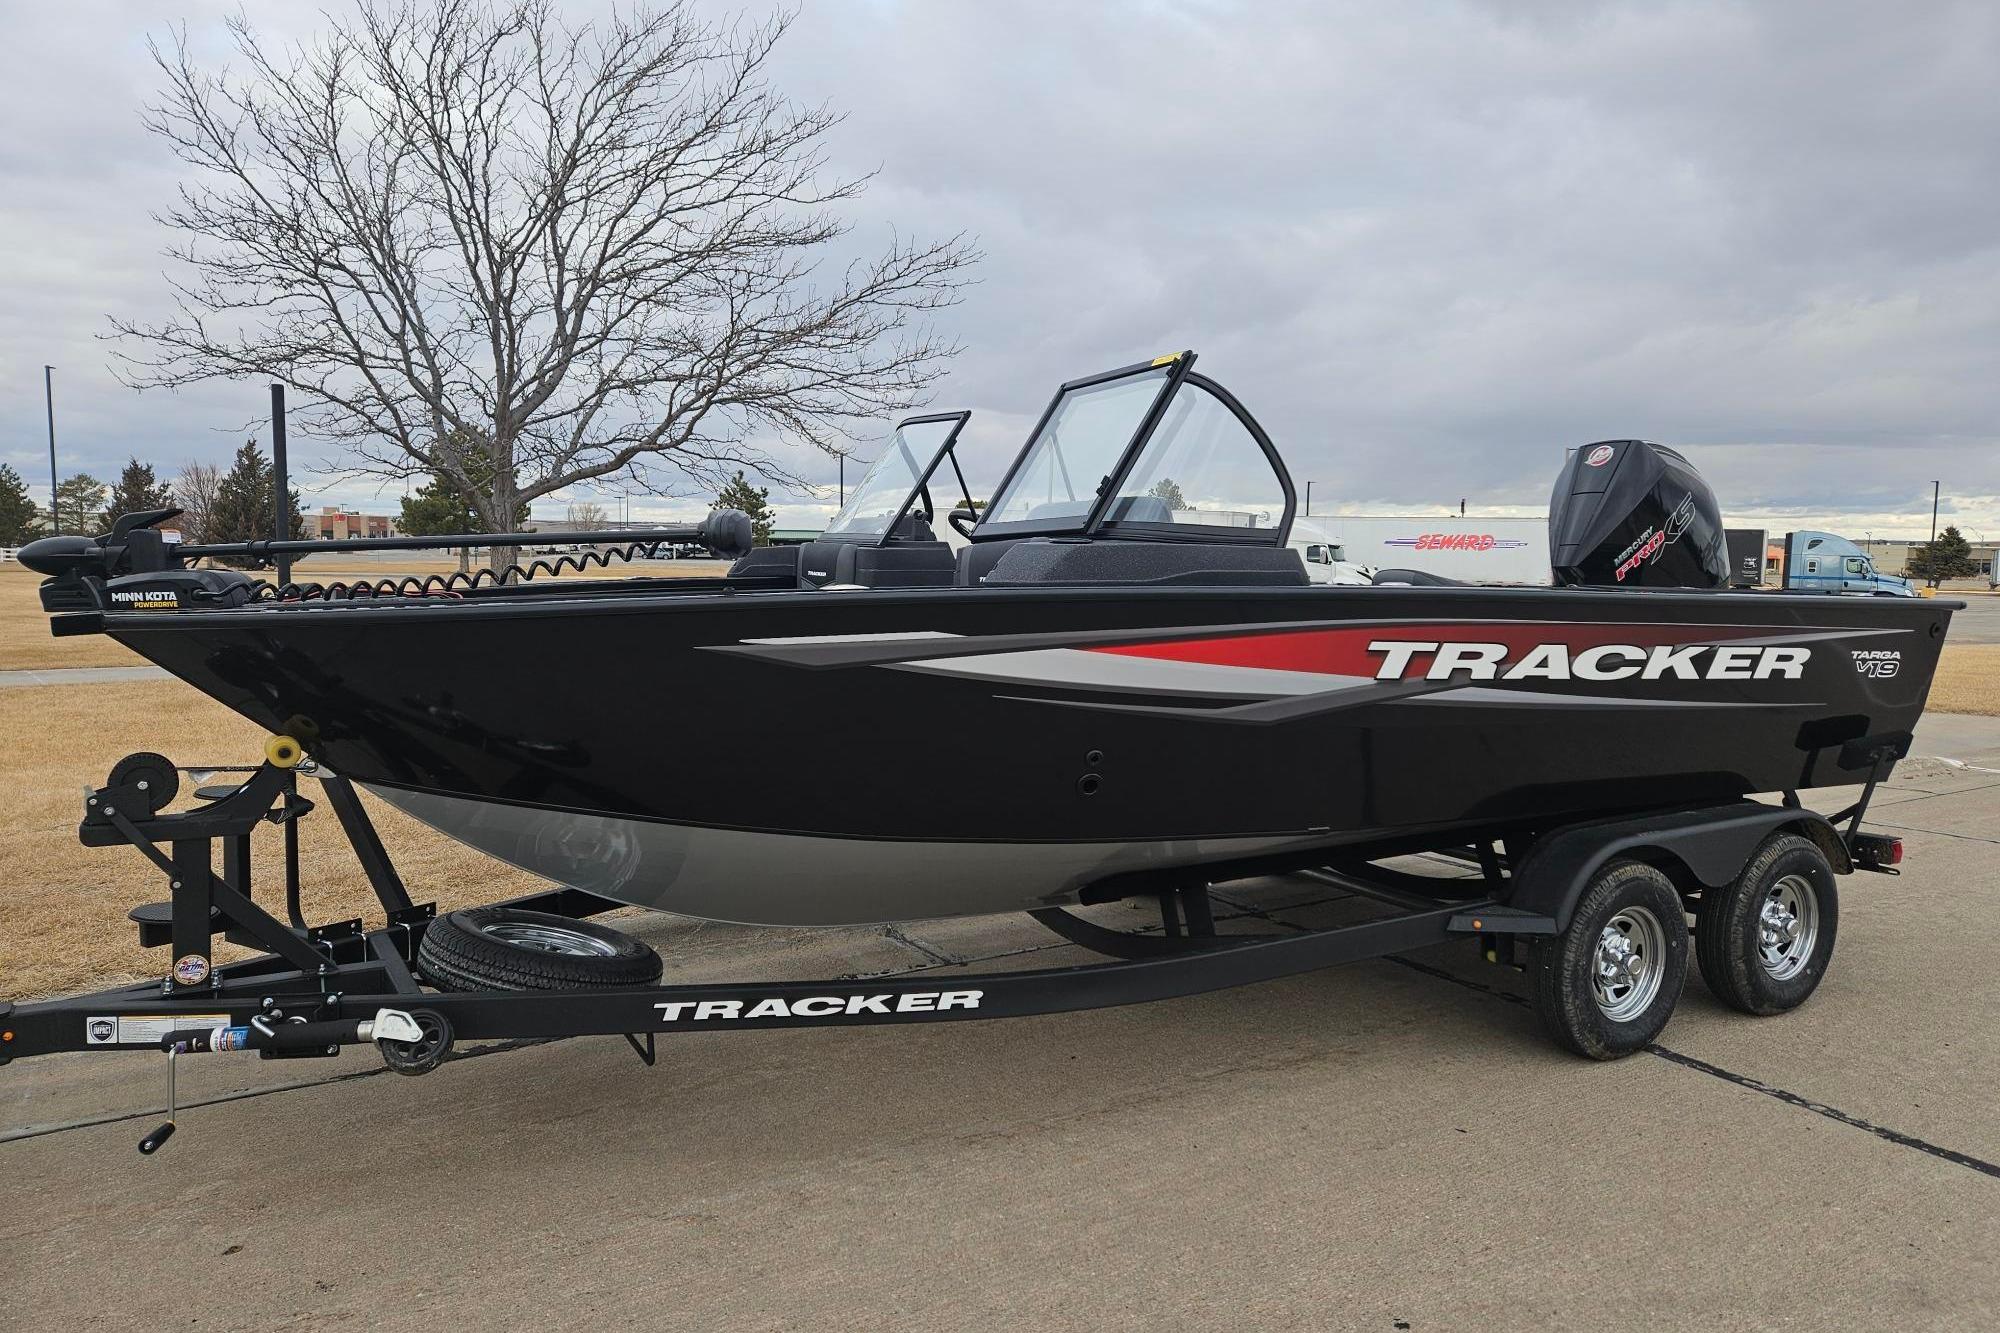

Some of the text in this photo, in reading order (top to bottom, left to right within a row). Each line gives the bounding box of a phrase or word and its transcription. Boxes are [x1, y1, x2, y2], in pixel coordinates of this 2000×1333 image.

[1414, 534, 1495, 551] SEWARD
[1614, 526, 1653, 566] MERCURY
[1616, 530, 1665, 581] PRO
[111, 591, 178, 602] MINN KOTA
[1367, 641, 1812, 681] TRACKER
[1851, 650, 1901, 660] TARGA
[1856, 660, 1900, 678] V19
[653, 990, 984, 1022] TRACKER
